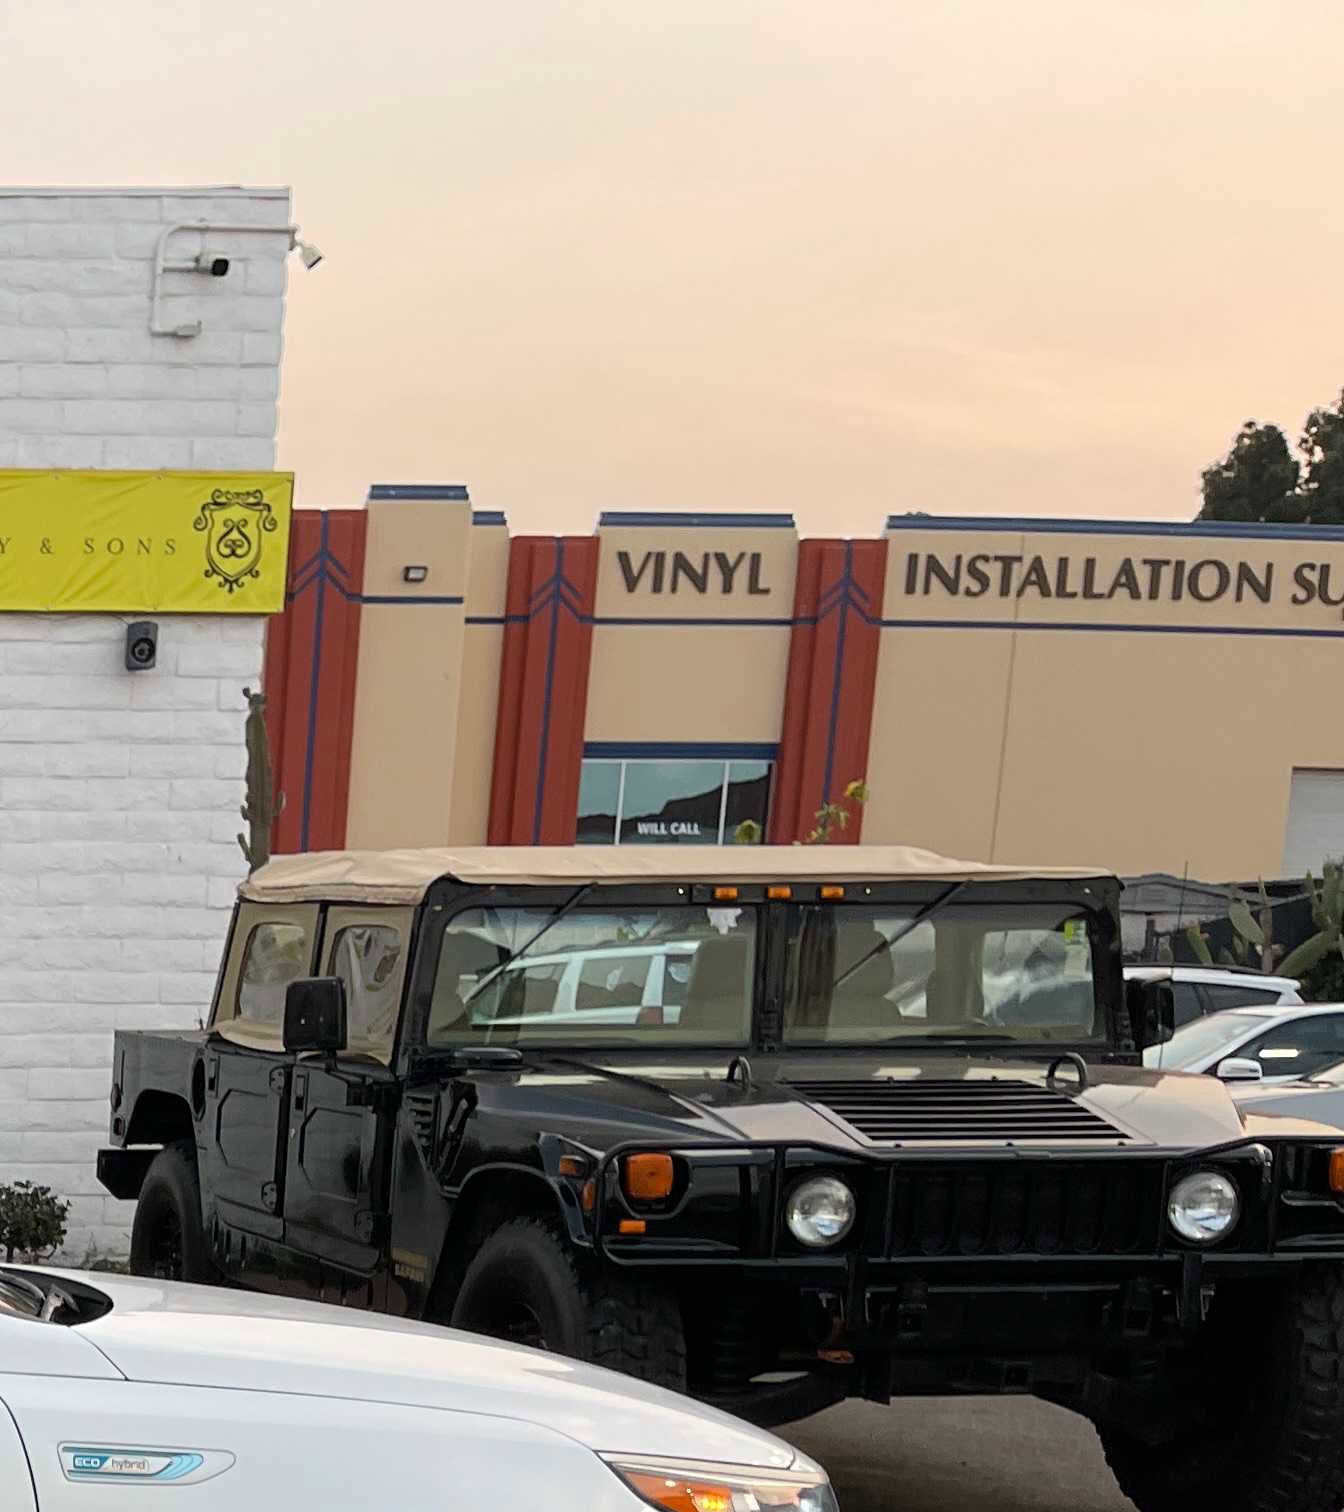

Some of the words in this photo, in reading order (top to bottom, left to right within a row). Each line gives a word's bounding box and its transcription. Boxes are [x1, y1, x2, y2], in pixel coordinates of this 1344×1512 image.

[39, 538, 54, 555] &
[83, 538, 178, 556] SONS
[616, 550, 771, 596] VINYL
[904, 552, 1274, 604] INSTALLATION
[637, 821, 668, 836] WILL
[669, 821, 702, 836] CALL
[74, 1456, 100, 1468] ECO
[111, 1458, 146, 1471] hybrid
